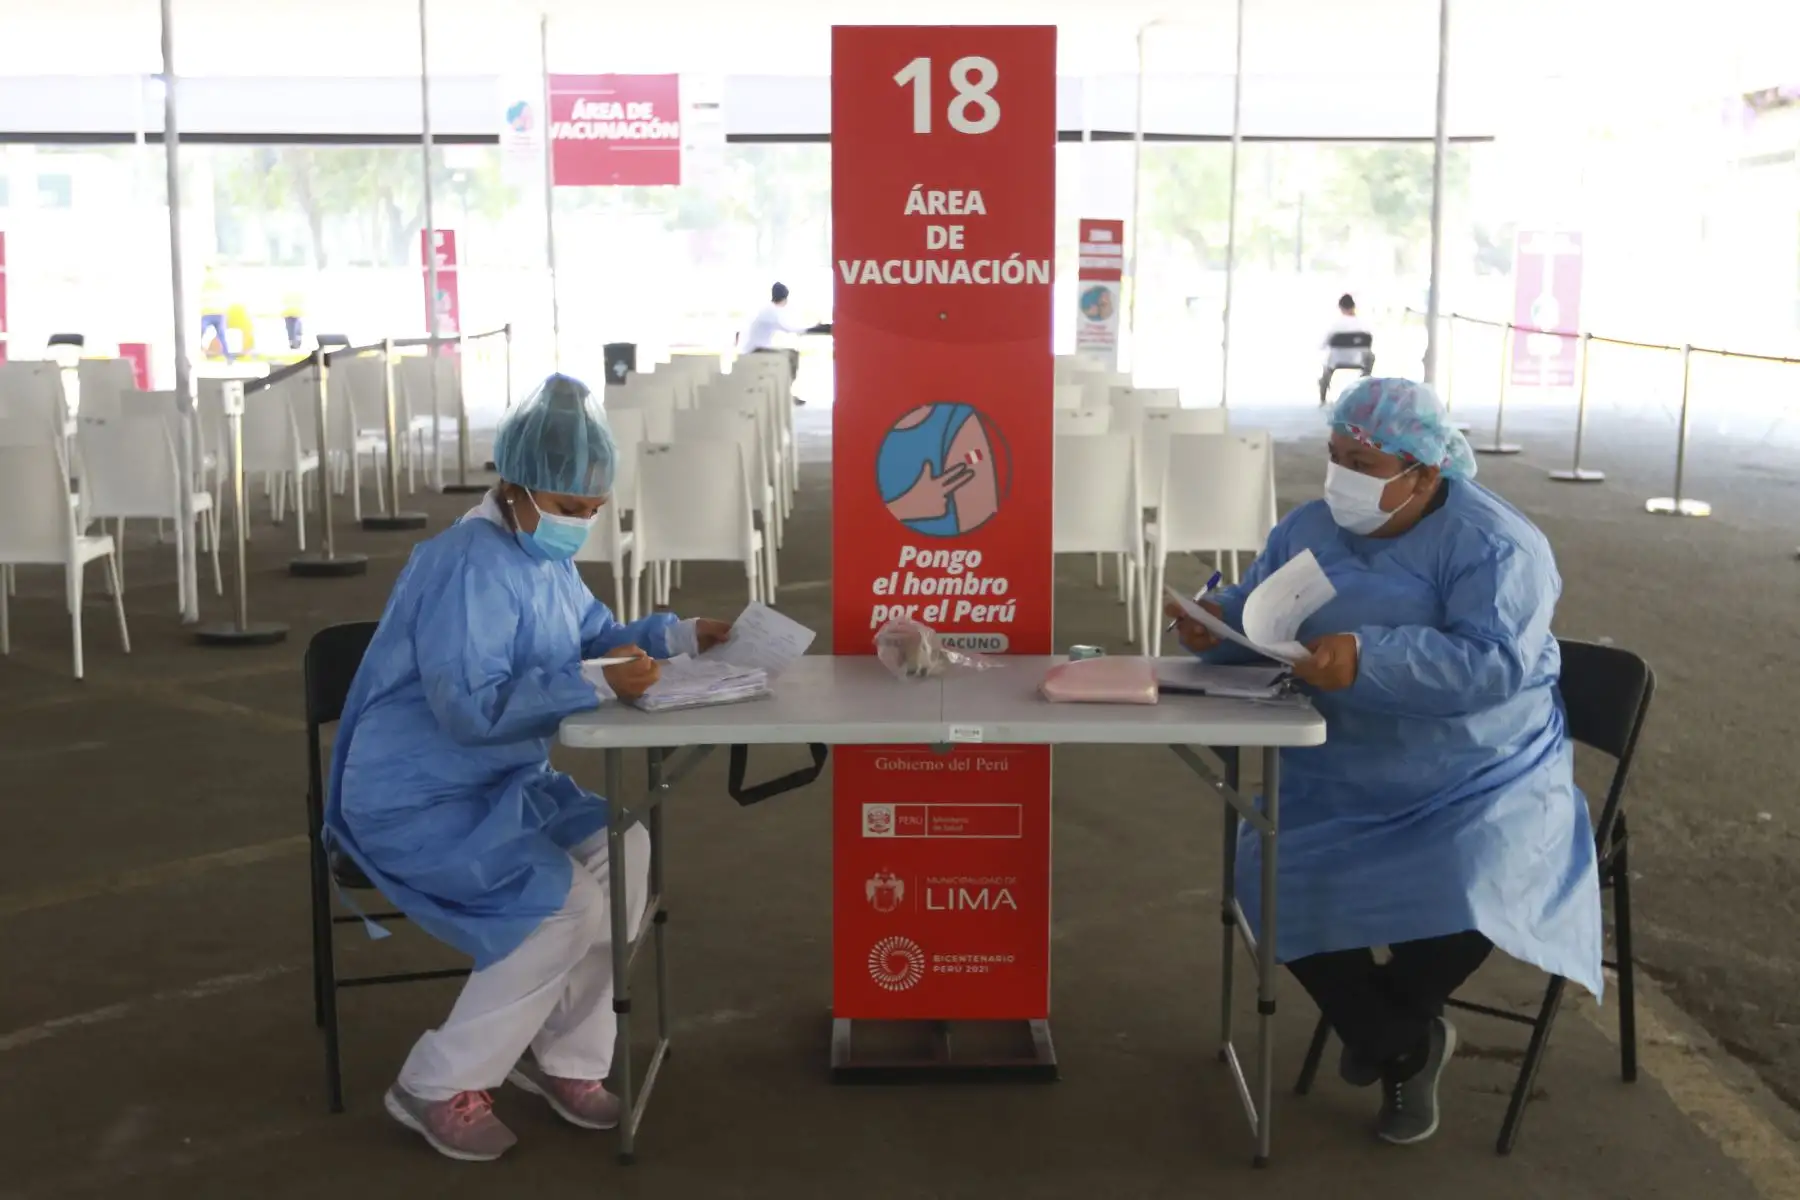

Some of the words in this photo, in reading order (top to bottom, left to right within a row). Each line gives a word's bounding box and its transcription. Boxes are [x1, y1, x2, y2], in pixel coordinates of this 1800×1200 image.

[893, 56, 1001, 135] 18
[571, 97, 625, 120] ÁREA
[625, 101, 654, 120] DE
[903, 183, 988, 216] ÁREA
[926, 225, 965, 250] DE
[838, 252, 1050, 285] VACUNACIÓN
[898, 545, 983, 575] Pongo
[872, 571, 899, 596] el
[902, 571, 1009, 596] hombro
[869, 603, 920, 630] por
[922, 599, 949, 623] el
[953, 598, 1017, 623] Perú
[875, 757, 945, 772] Gobierno
[948, 757, 971, 772] del
[976, 757, 1010, 772] Perú
[926, 887, 1018, 911] LIMA
[932, 954, 1016, 963] BICENTENARIO
